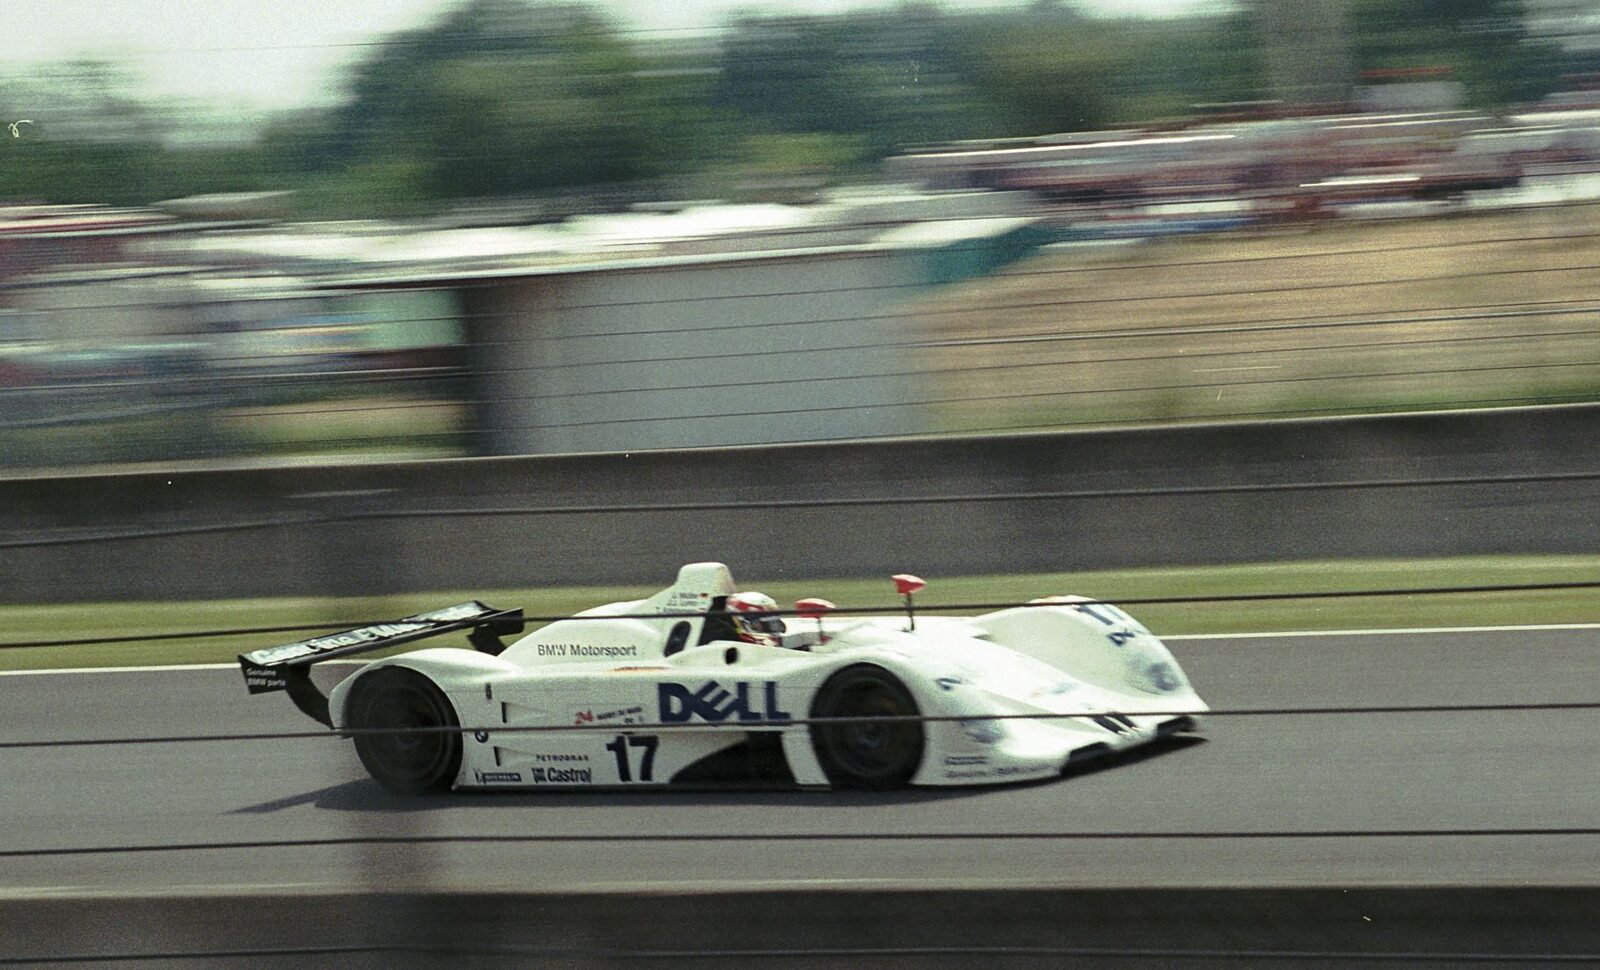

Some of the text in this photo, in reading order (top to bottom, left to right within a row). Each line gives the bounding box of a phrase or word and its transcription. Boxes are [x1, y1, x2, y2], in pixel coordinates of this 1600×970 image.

[537, 644, 637, 658] BMW Motorsport
[658, 680, 791, 722] DELL
[606, 735, 659, 782] 17
[547, 766, 592, 783] Castrol
